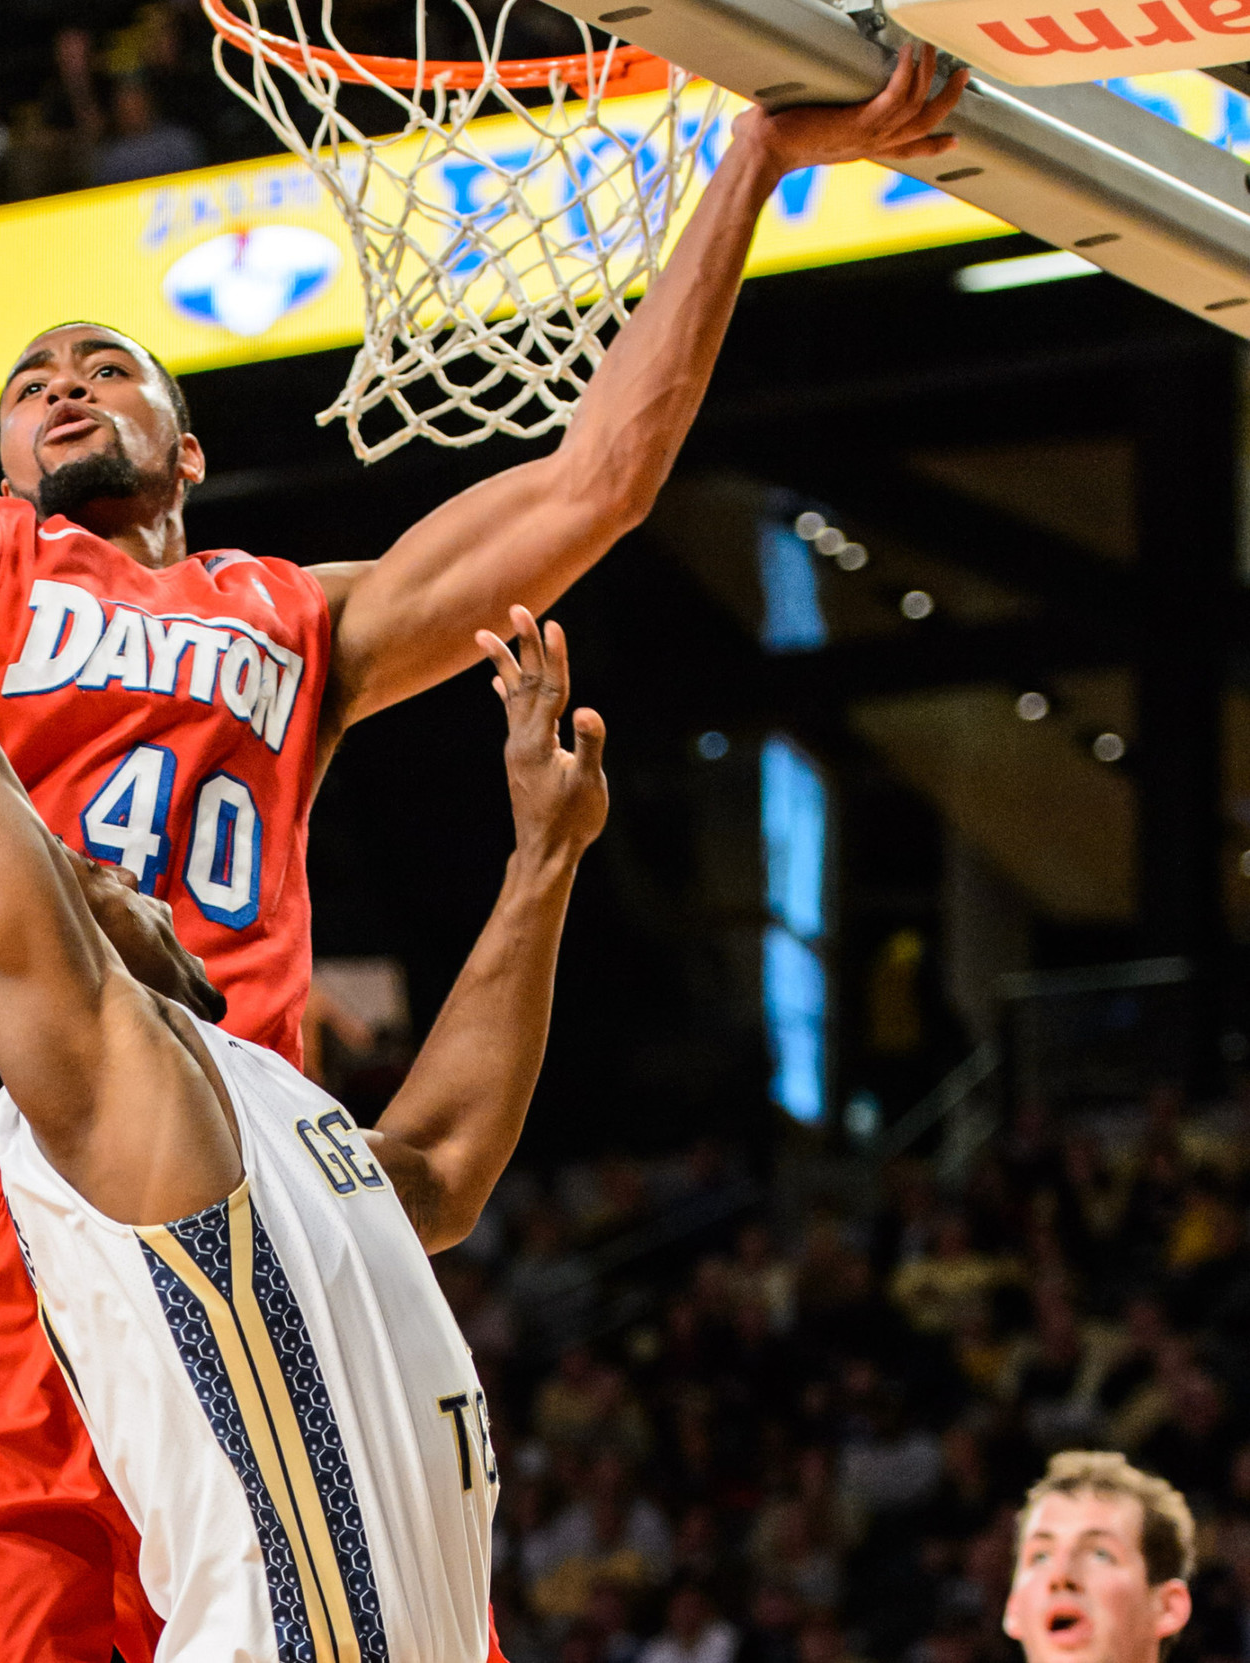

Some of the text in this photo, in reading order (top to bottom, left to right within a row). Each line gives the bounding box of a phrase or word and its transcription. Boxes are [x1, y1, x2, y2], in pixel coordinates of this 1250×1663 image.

[976, 0, 1250, 56] arm
[1, 579, 304, 755] DAYTON
[80, 742, 263, 931] 40
